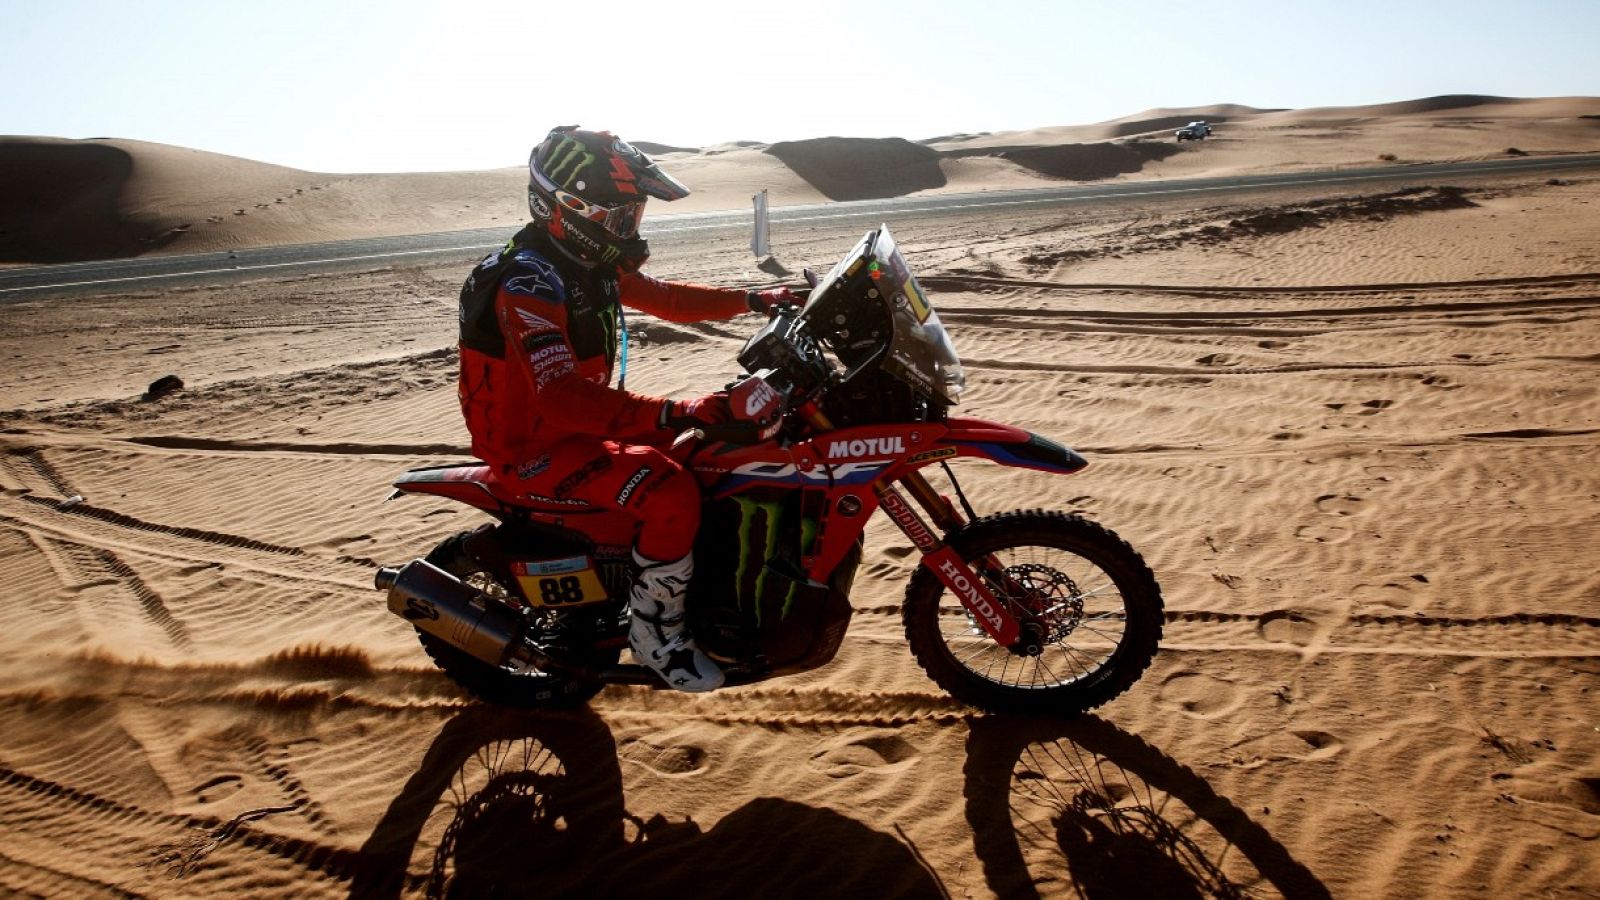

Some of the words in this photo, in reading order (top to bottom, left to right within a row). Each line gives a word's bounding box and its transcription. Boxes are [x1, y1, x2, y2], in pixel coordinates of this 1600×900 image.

[560, 217, 601, 251] MONSTER
[530, 344, 569, 363] MOTUL
[829, 436, 905, 458] MOTUL
[617, 468, 651, 507] HONDA
[538, 575, 585, 604] 88
[938, 559, 1003, 632] HONDA
